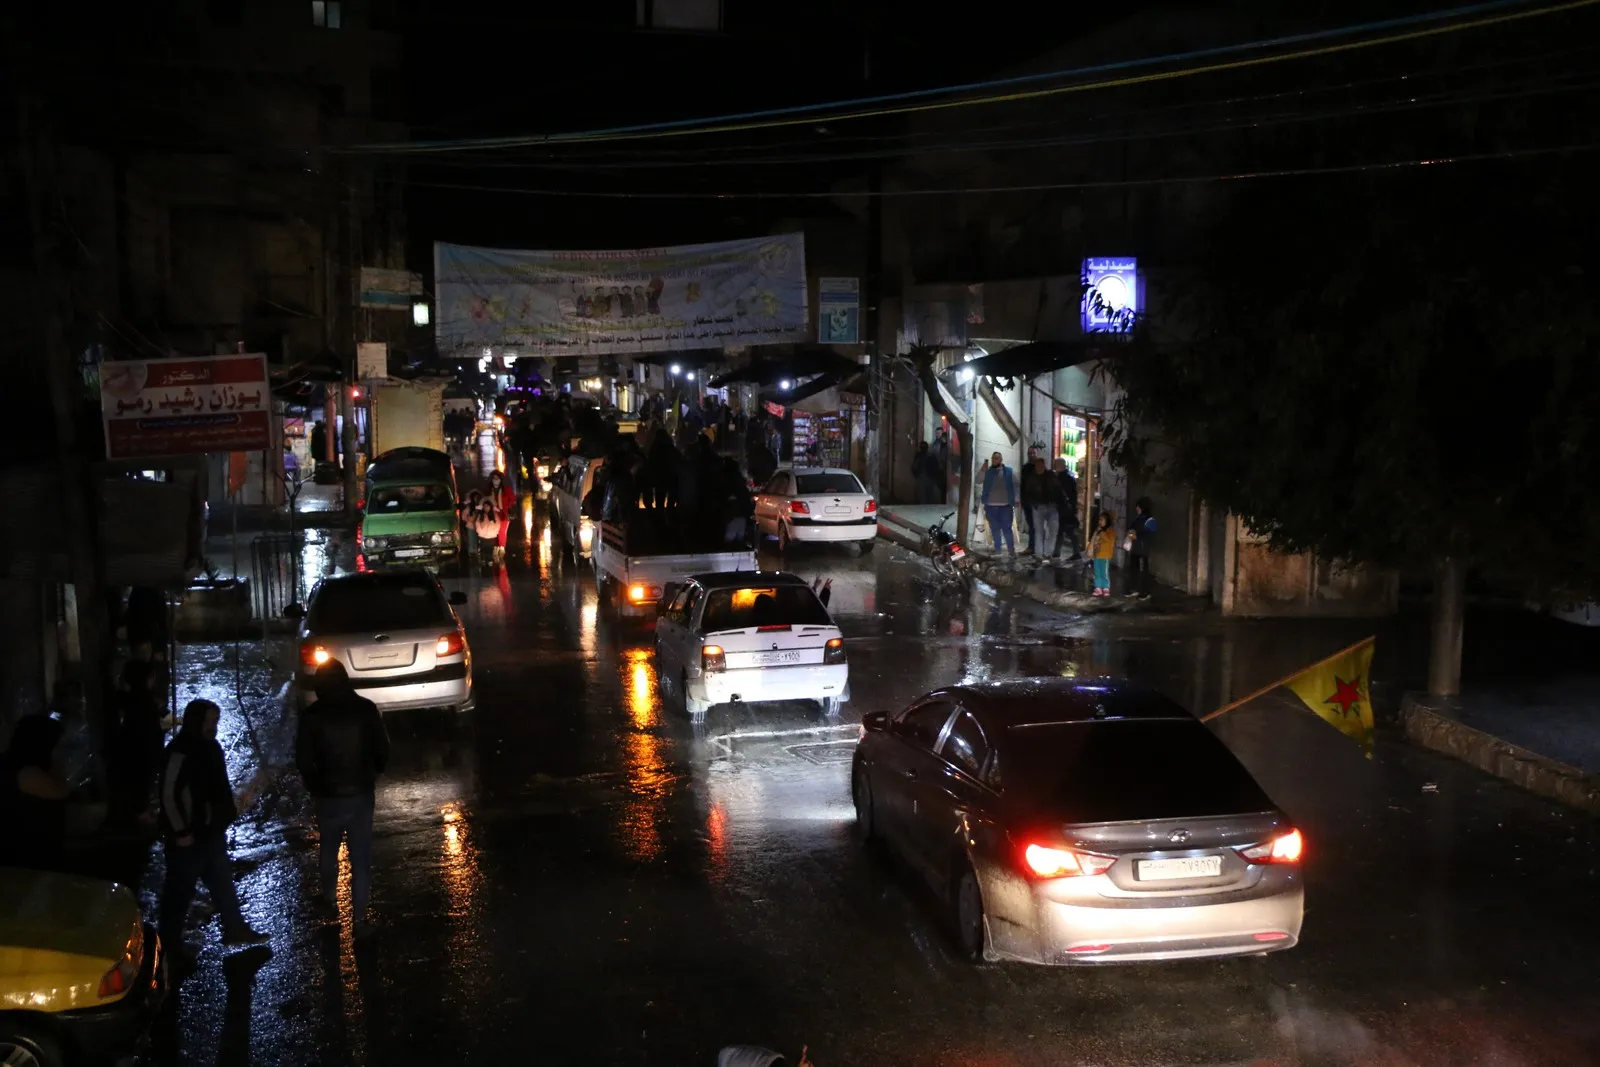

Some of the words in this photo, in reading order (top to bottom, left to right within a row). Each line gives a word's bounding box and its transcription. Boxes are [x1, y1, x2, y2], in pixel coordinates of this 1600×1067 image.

[1087, 258, 1135, 273] صيدلية
[160, 368, 210, 385] الدكتور
[114, 397, 153, 416] رمو
[159, 387, 204, 413] رشيد
[209, 386, 262, 410] بوزان
